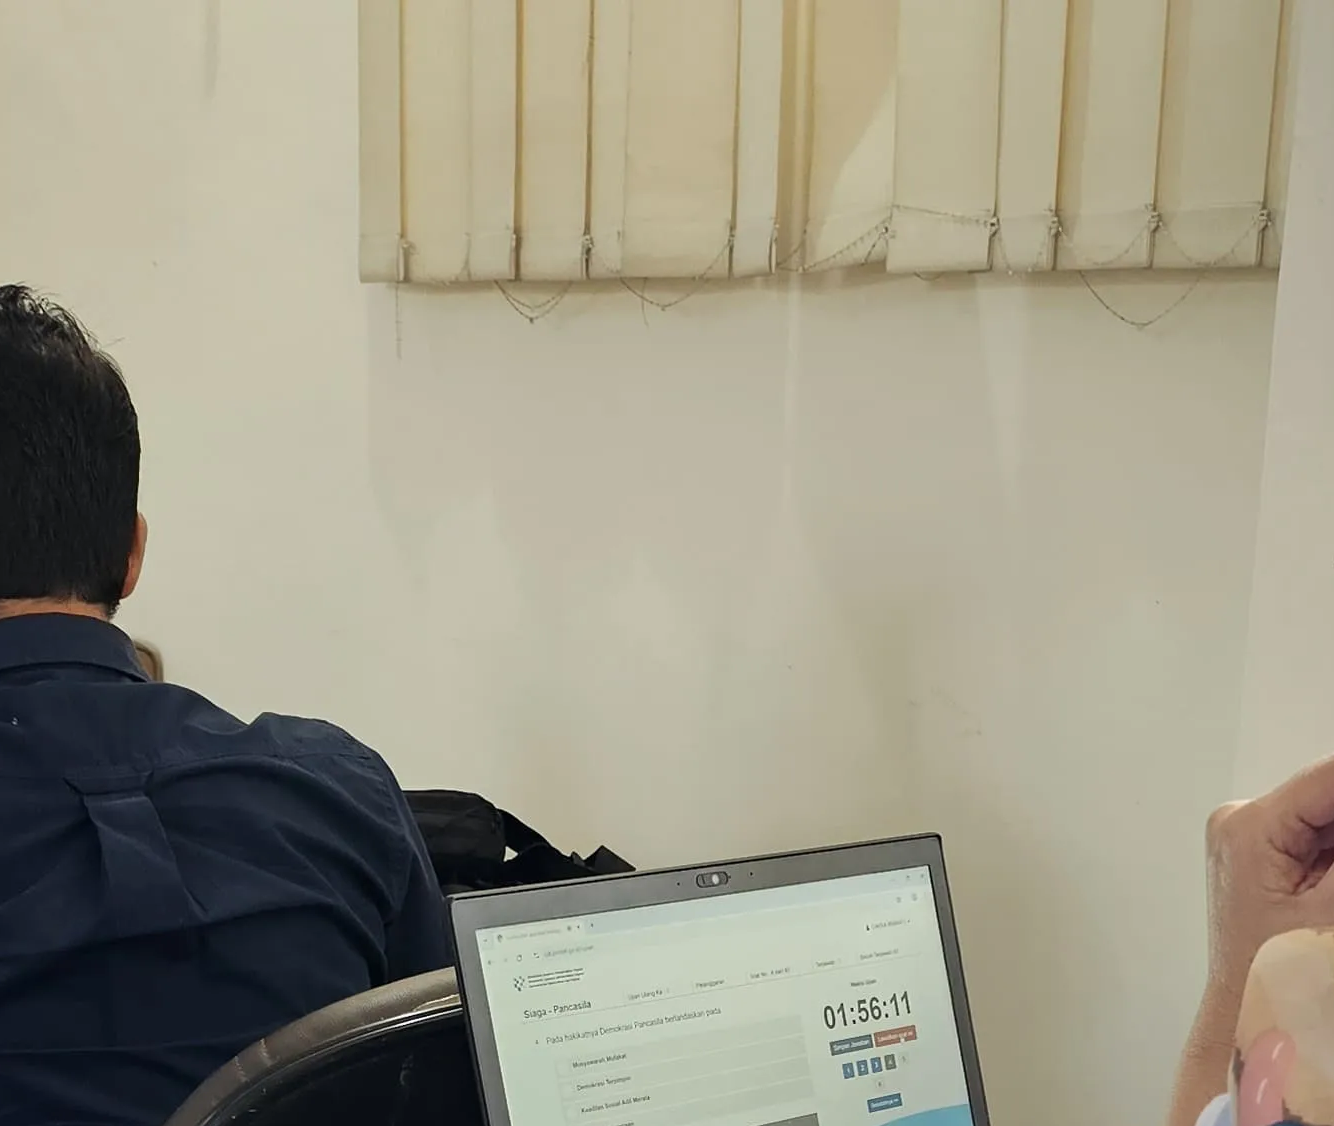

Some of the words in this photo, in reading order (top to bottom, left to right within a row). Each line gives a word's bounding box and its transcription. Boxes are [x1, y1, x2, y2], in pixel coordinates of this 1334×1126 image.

[523, 1007, 547, 1020] Siaga
[553, 1000, 592, 1014] Pancasila
[823, 990, 911, 1029] 01:56:11
[546, 1034, 564, 1044] Pada
[599, 1022, 633, 1036] Demokrasi
[634, 1016, 664, 1029] Pancasila
